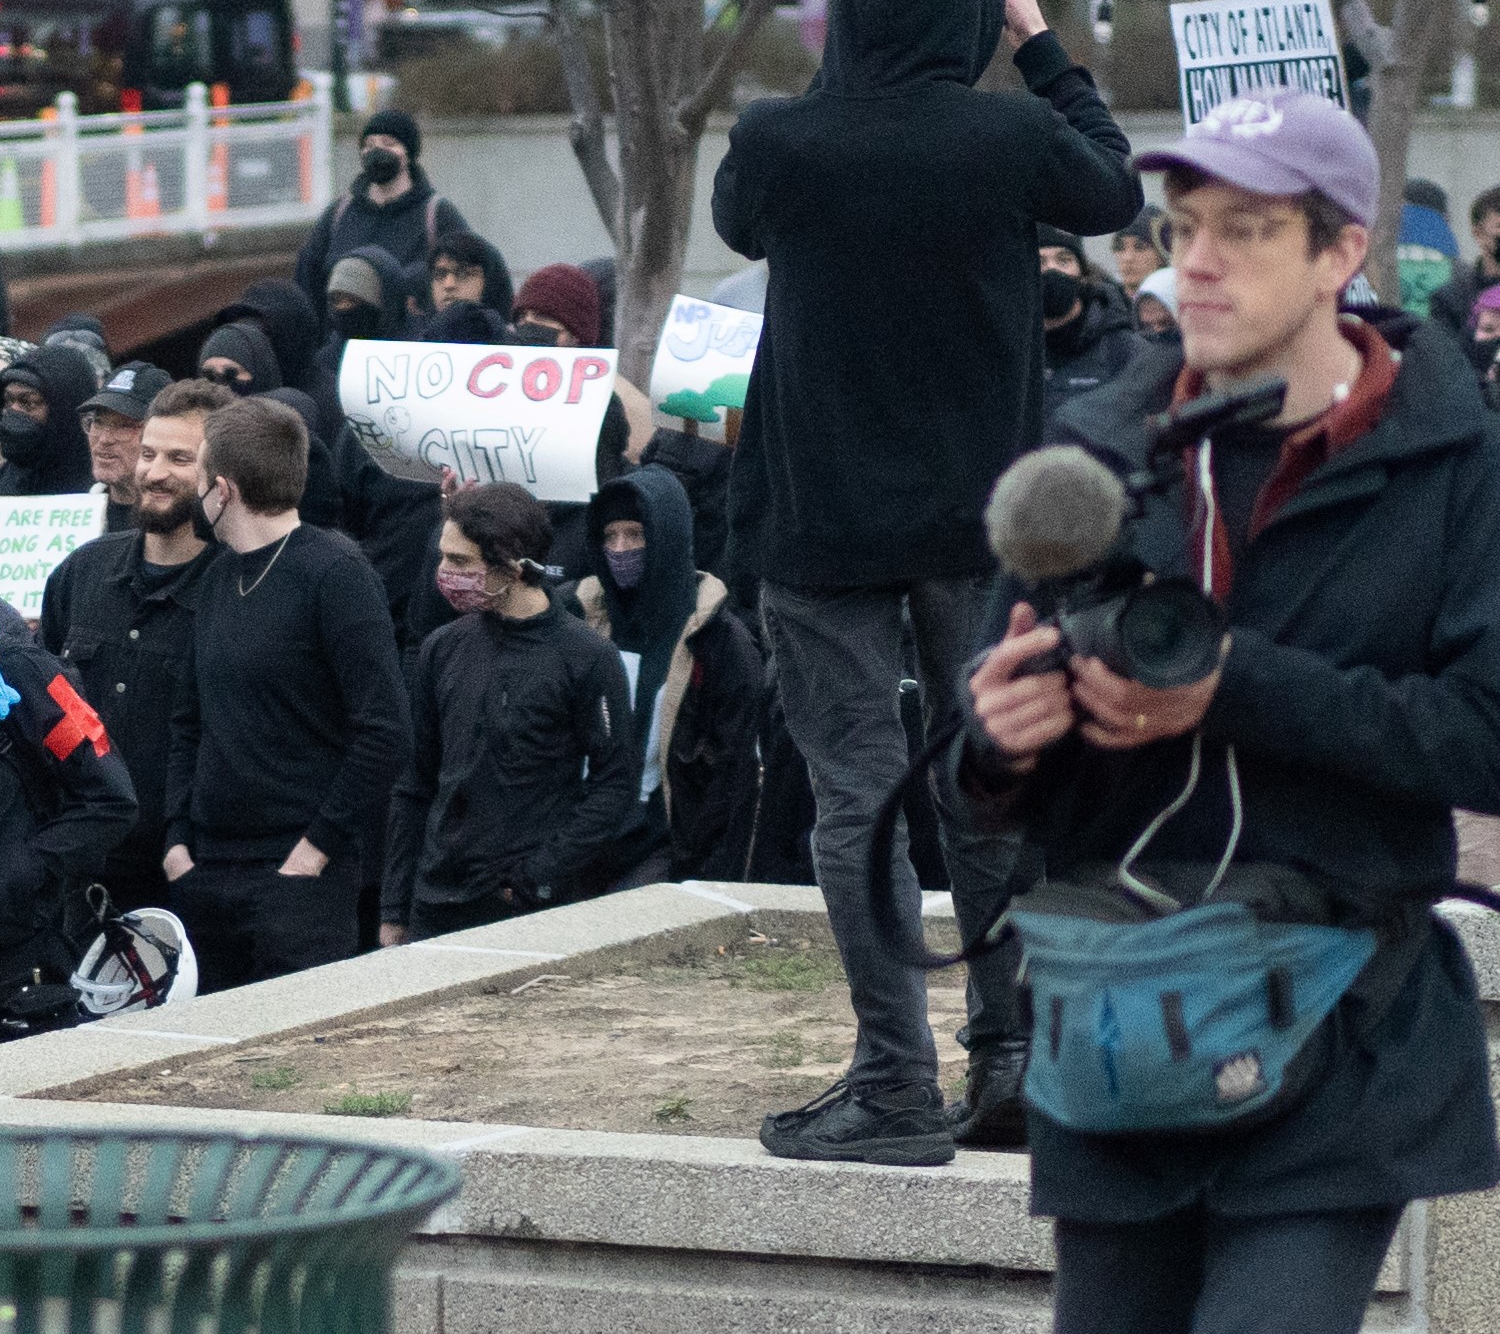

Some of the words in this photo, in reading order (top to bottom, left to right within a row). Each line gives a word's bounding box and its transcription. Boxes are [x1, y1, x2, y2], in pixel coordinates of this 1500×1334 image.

[1184, 11, 1224, 60] CITY
[1228, 9, 1248, 56] OF
[367, 351, 453, 405] NO
[467, 351, 610, 405] COP
[418, 426, 547, 484] CITY
[5, 508, 44, 527] ARE
[49, 508, 93, 528] FREE
[46, 533, 77, 553] AS
[22, 591, 43, 608] IT
